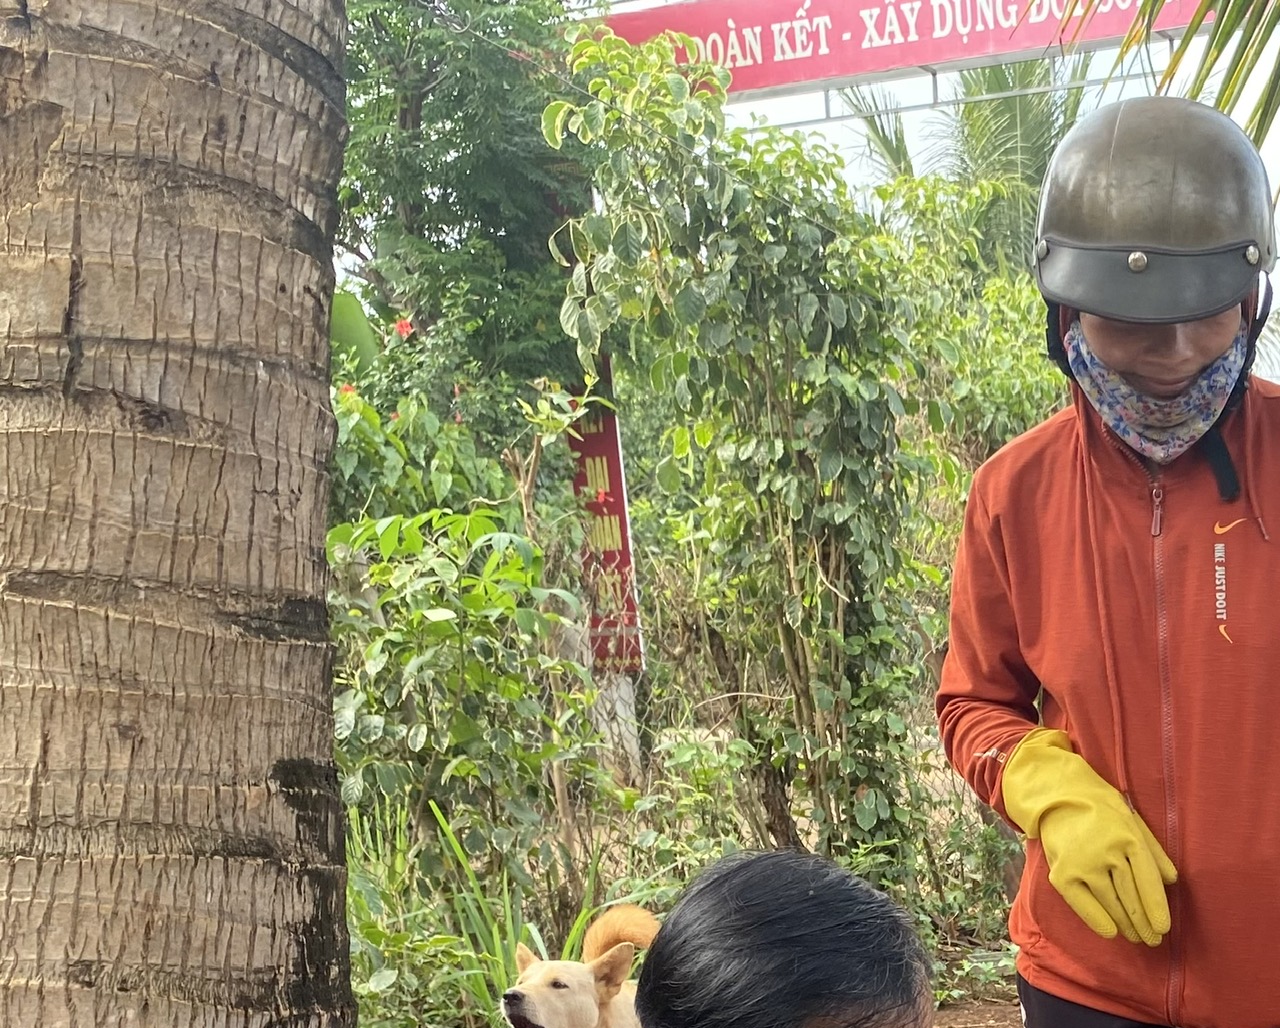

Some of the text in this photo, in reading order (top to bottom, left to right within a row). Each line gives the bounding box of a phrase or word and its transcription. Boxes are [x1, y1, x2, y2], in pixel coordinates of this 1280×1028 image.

[771, 0, 832, 62] KẾT
[1214, 543, 1227, 620] NIKE JUST DO IT
